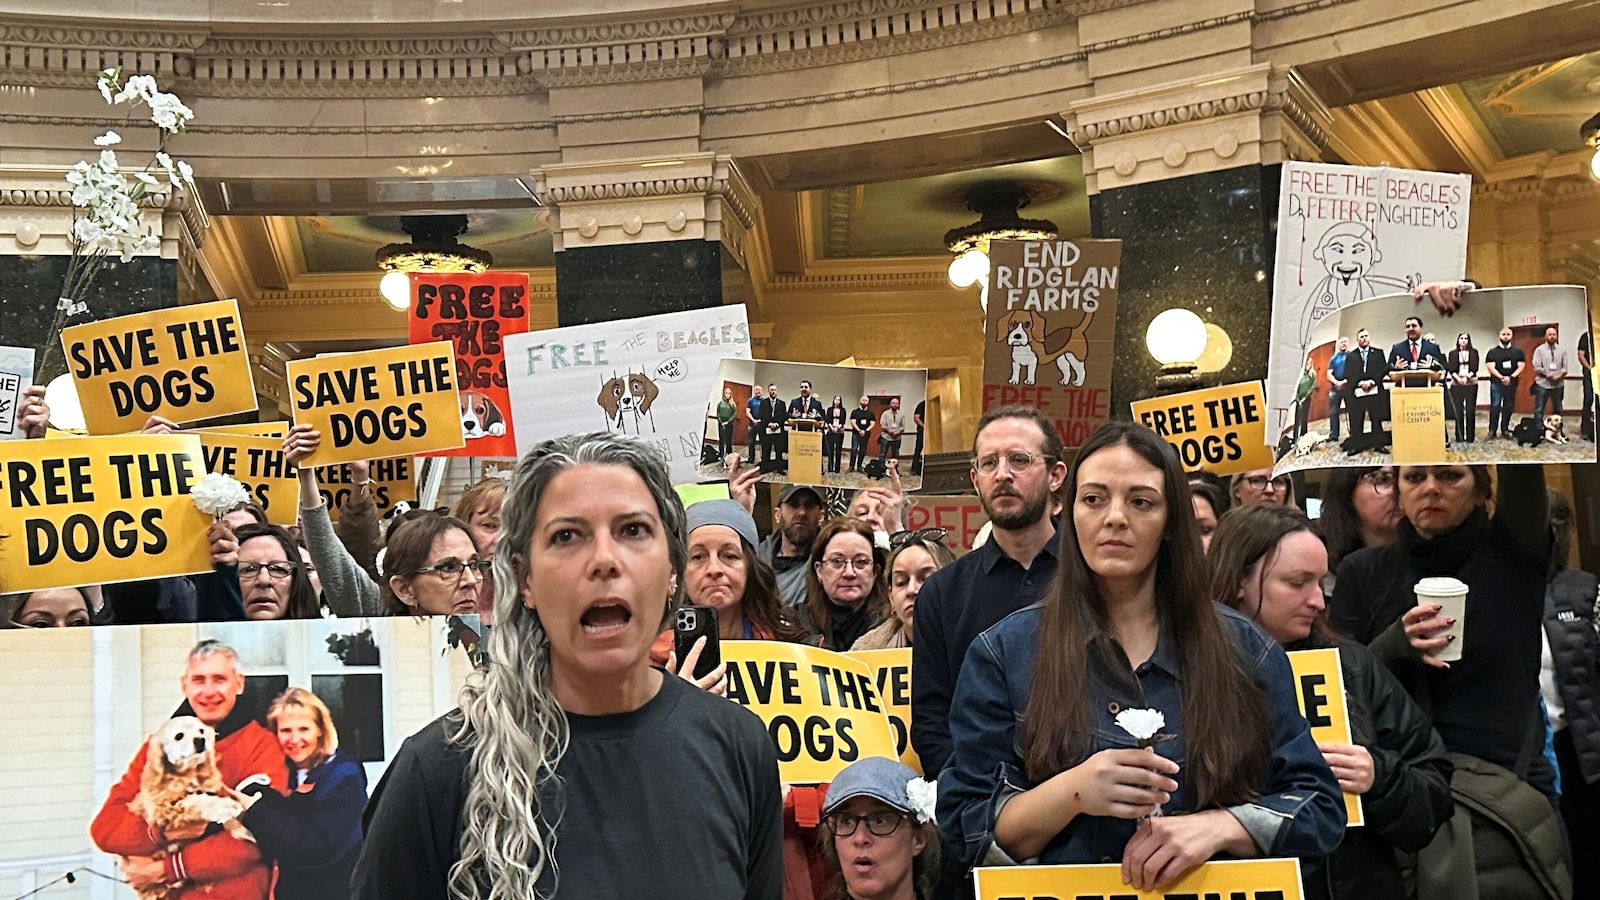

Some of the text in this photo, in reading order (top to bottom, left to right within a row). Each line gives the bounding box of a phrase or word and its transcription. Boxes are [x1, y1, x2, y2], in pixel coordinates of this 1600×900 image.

[1290, 170, 1461, 204] FREE THE BEAGLES
[1307, 196, 1362, 222] PETER
[1023, 241, 1081, 268] END
[997, 266, 1118, 290] RIDGLAN
[415, 284, 525, 320] FREE
[1006, 288, 1099, 313] FARMS
[70, 316, 240, 379] SAVE THE
[432, 320, 501, 356] THE
[526, 322, 749, 376] FREE THE BEAGLES
[295, 356, 453, 410] SAVE THE
[456, 358, 508, 391] OGS
[658, 359, 679, 376] HELP
[668, 368, 682, 378] ME
[109, 366, 215, 417] DOGS
[1063, 388, 1108, 419] THE
[330, 403, 427, 448] DOGS
[1141, 404, 1197, 437] FREE
[1203, 394, 1259, 429] THE
[202, 445, 237, 476] VE
[314, 462, 353, 484] REE
[0, 457, 95, 508] REE
[109, 453, 194, 499] THE
[25, 508, 168, 566] DOGS
[908, 504, 981, 549] REE
[726, 661, 881, 714] AVE THE
[876, 666, 910, 706] VE
[766, 715, 859, 762] OGS
